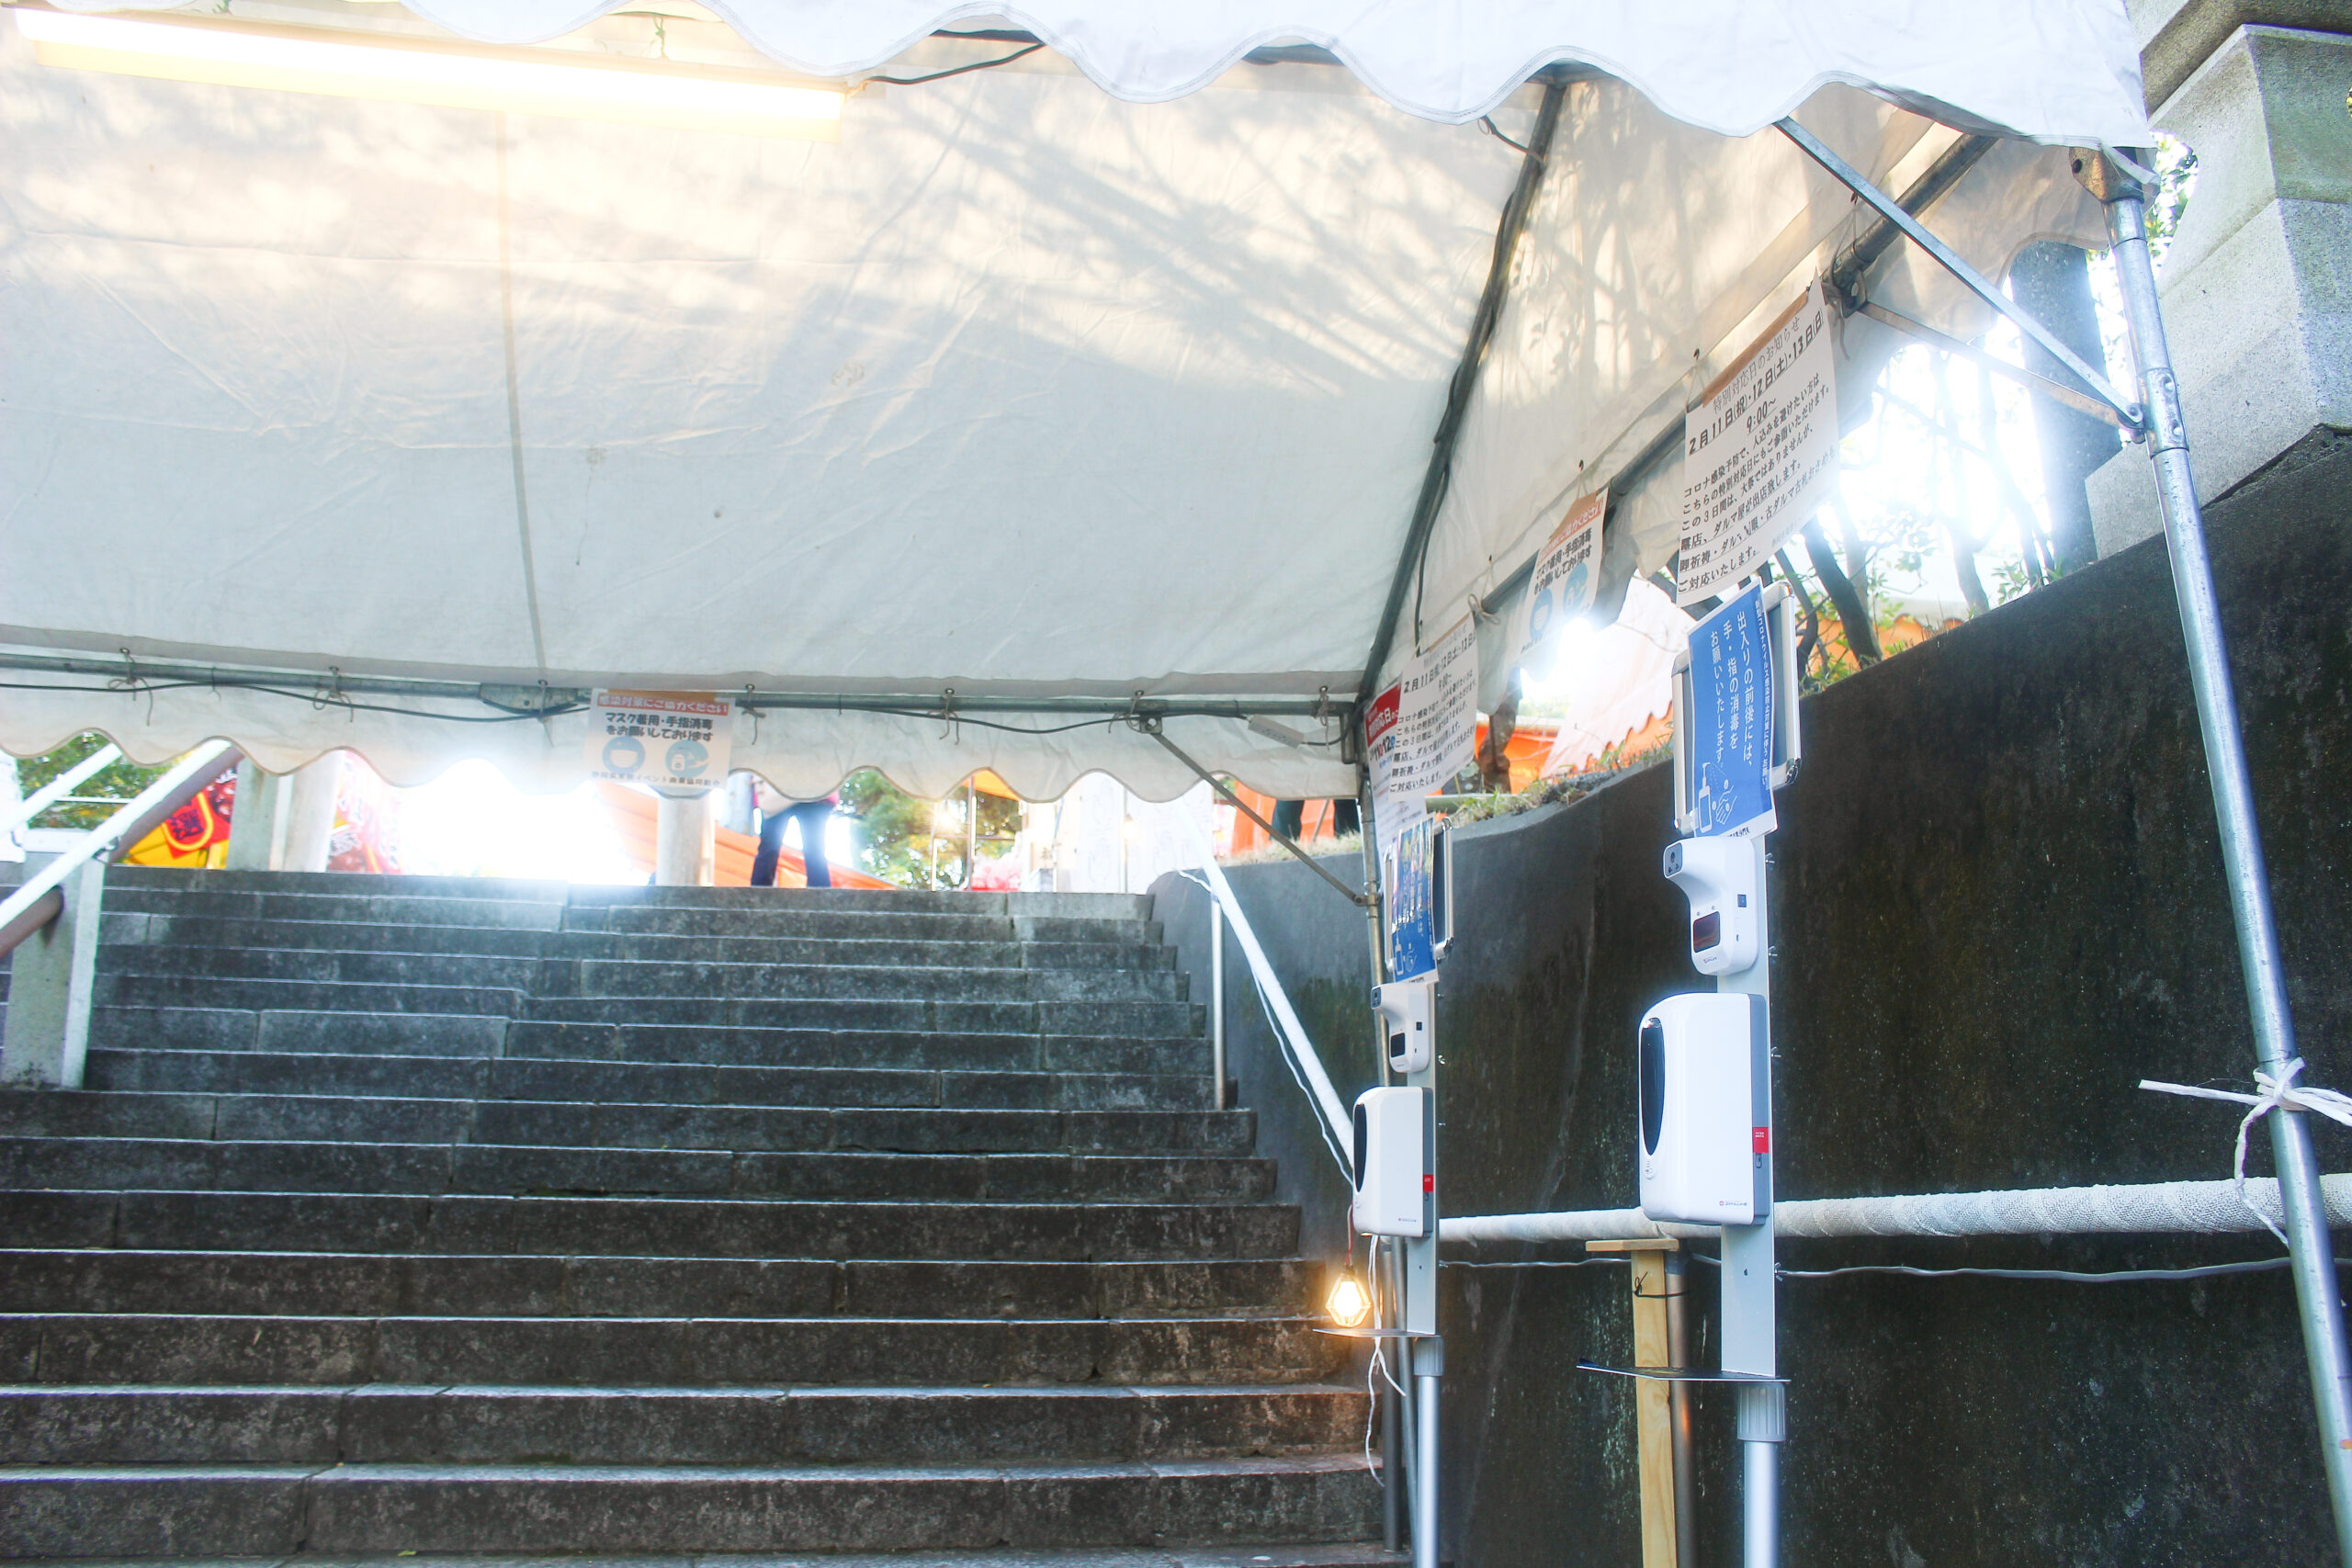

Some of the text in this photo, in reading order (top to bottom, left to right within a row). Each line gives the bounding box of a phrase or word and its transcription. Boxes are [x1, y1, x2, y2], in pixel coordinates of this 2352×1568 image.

[1713, 316, 1801, 413] 特別対応日のお知らせ
[1678, 546, 1757, 593] ご対応いたします。
[1723, 619, 1740, 750] 手・指の消毒を
[1736, 611, 1755, 767] 出入りの前後には、
